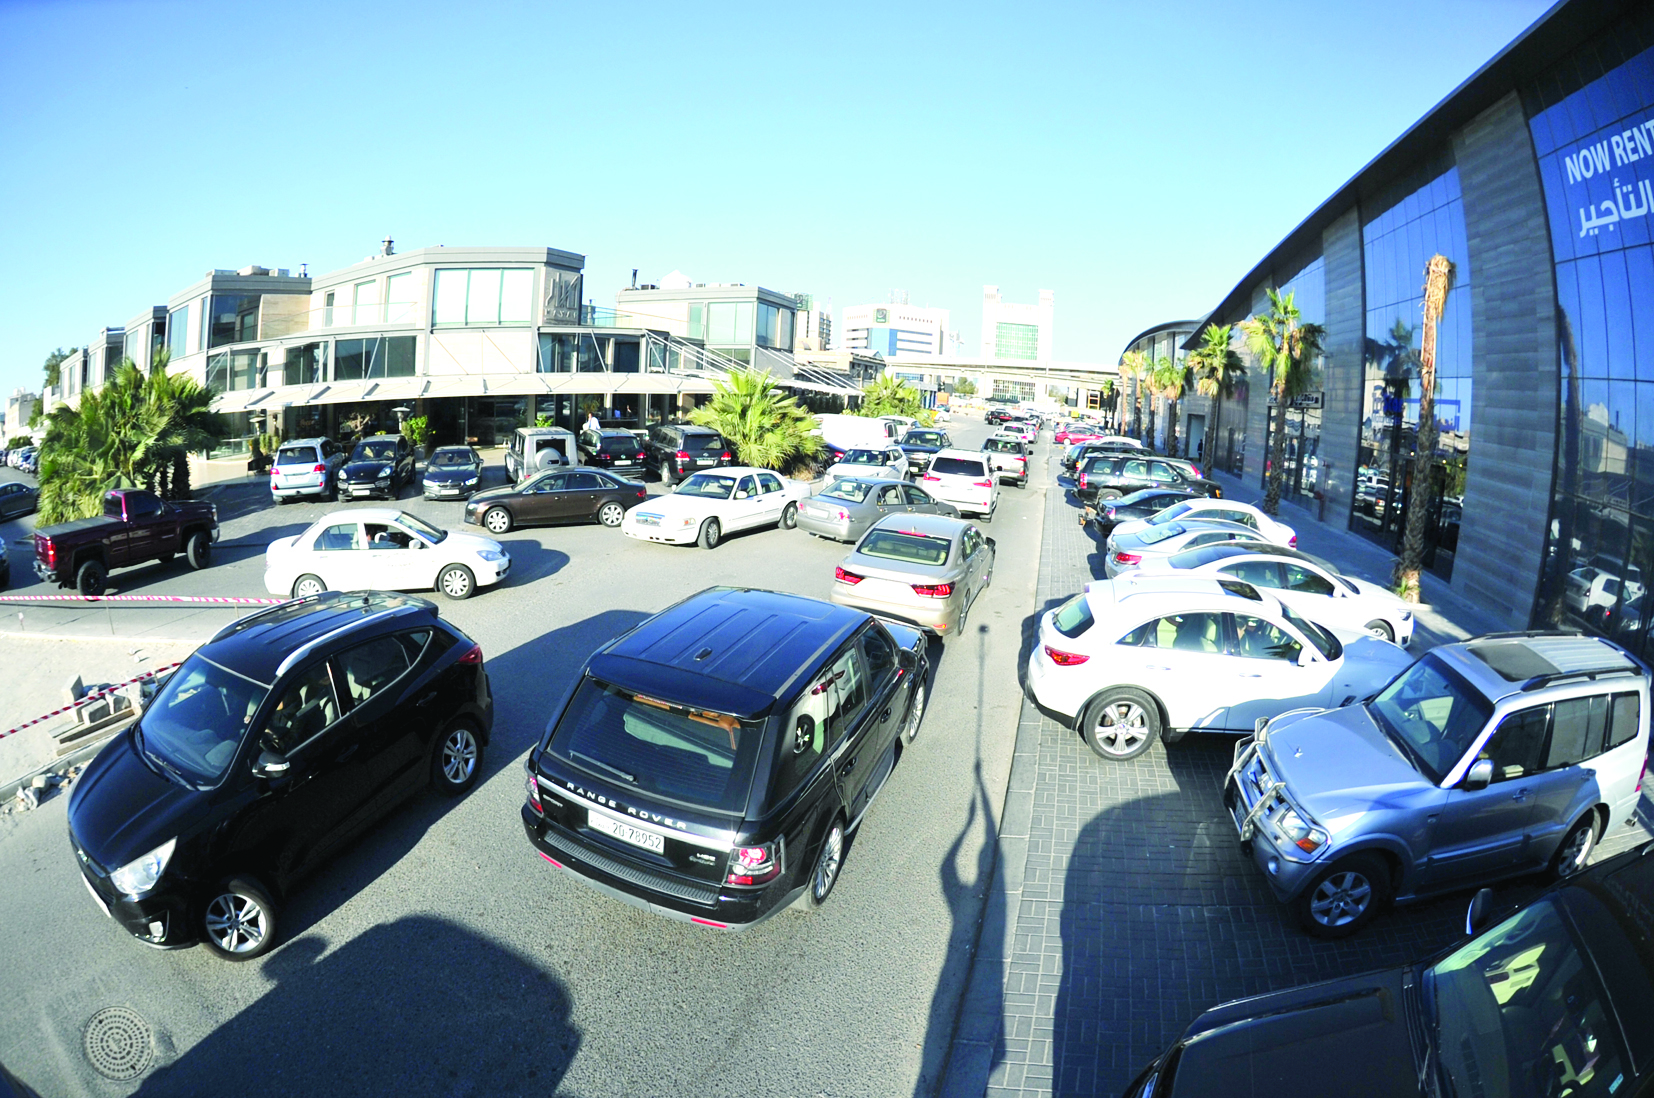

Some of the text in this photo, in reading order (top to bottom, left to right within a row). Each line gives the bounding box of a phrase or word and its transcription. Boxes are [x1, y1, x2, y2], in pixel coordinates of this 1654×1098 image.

[1564, 140, 1611, 185] NOW
[1579, 178, 1654, 238] التأجير
[566, 782, 617, 808] RANGE
[627, 806, 687, 830] ROVER
